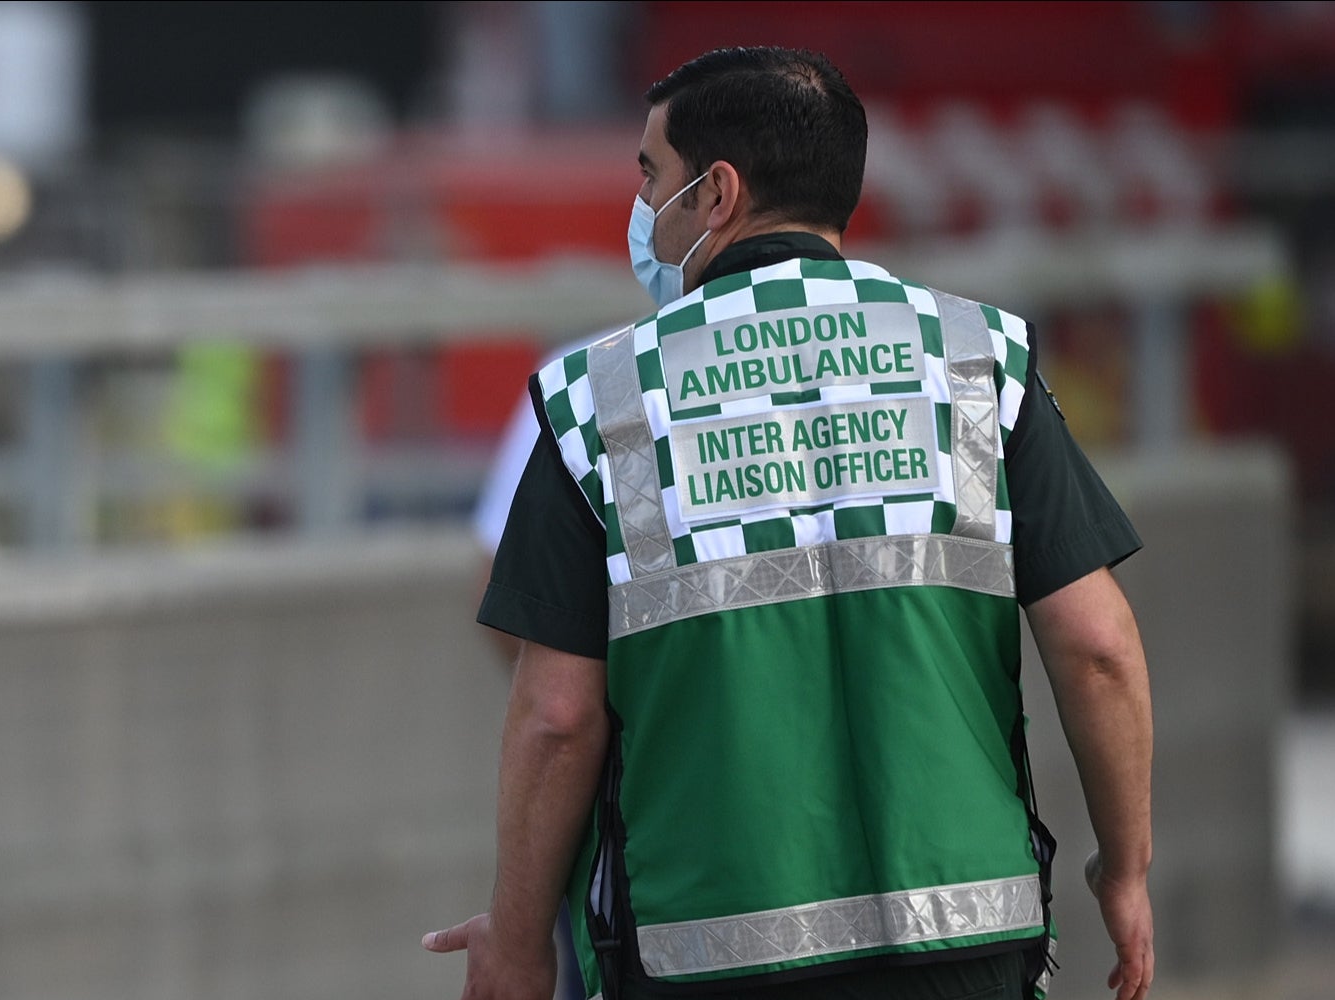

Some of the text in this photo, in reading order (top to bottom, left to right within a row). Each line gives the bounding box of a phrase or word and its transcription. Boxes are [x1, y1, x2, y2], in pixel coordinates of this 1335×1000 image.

[714, 311, 867, 356] LONDON
[680, 342, 914, 400] AMBULANCE
[698, 409, 908, 464] INTER AGENCY
[689, 448, 928, 505] LIAISON OFFICER
